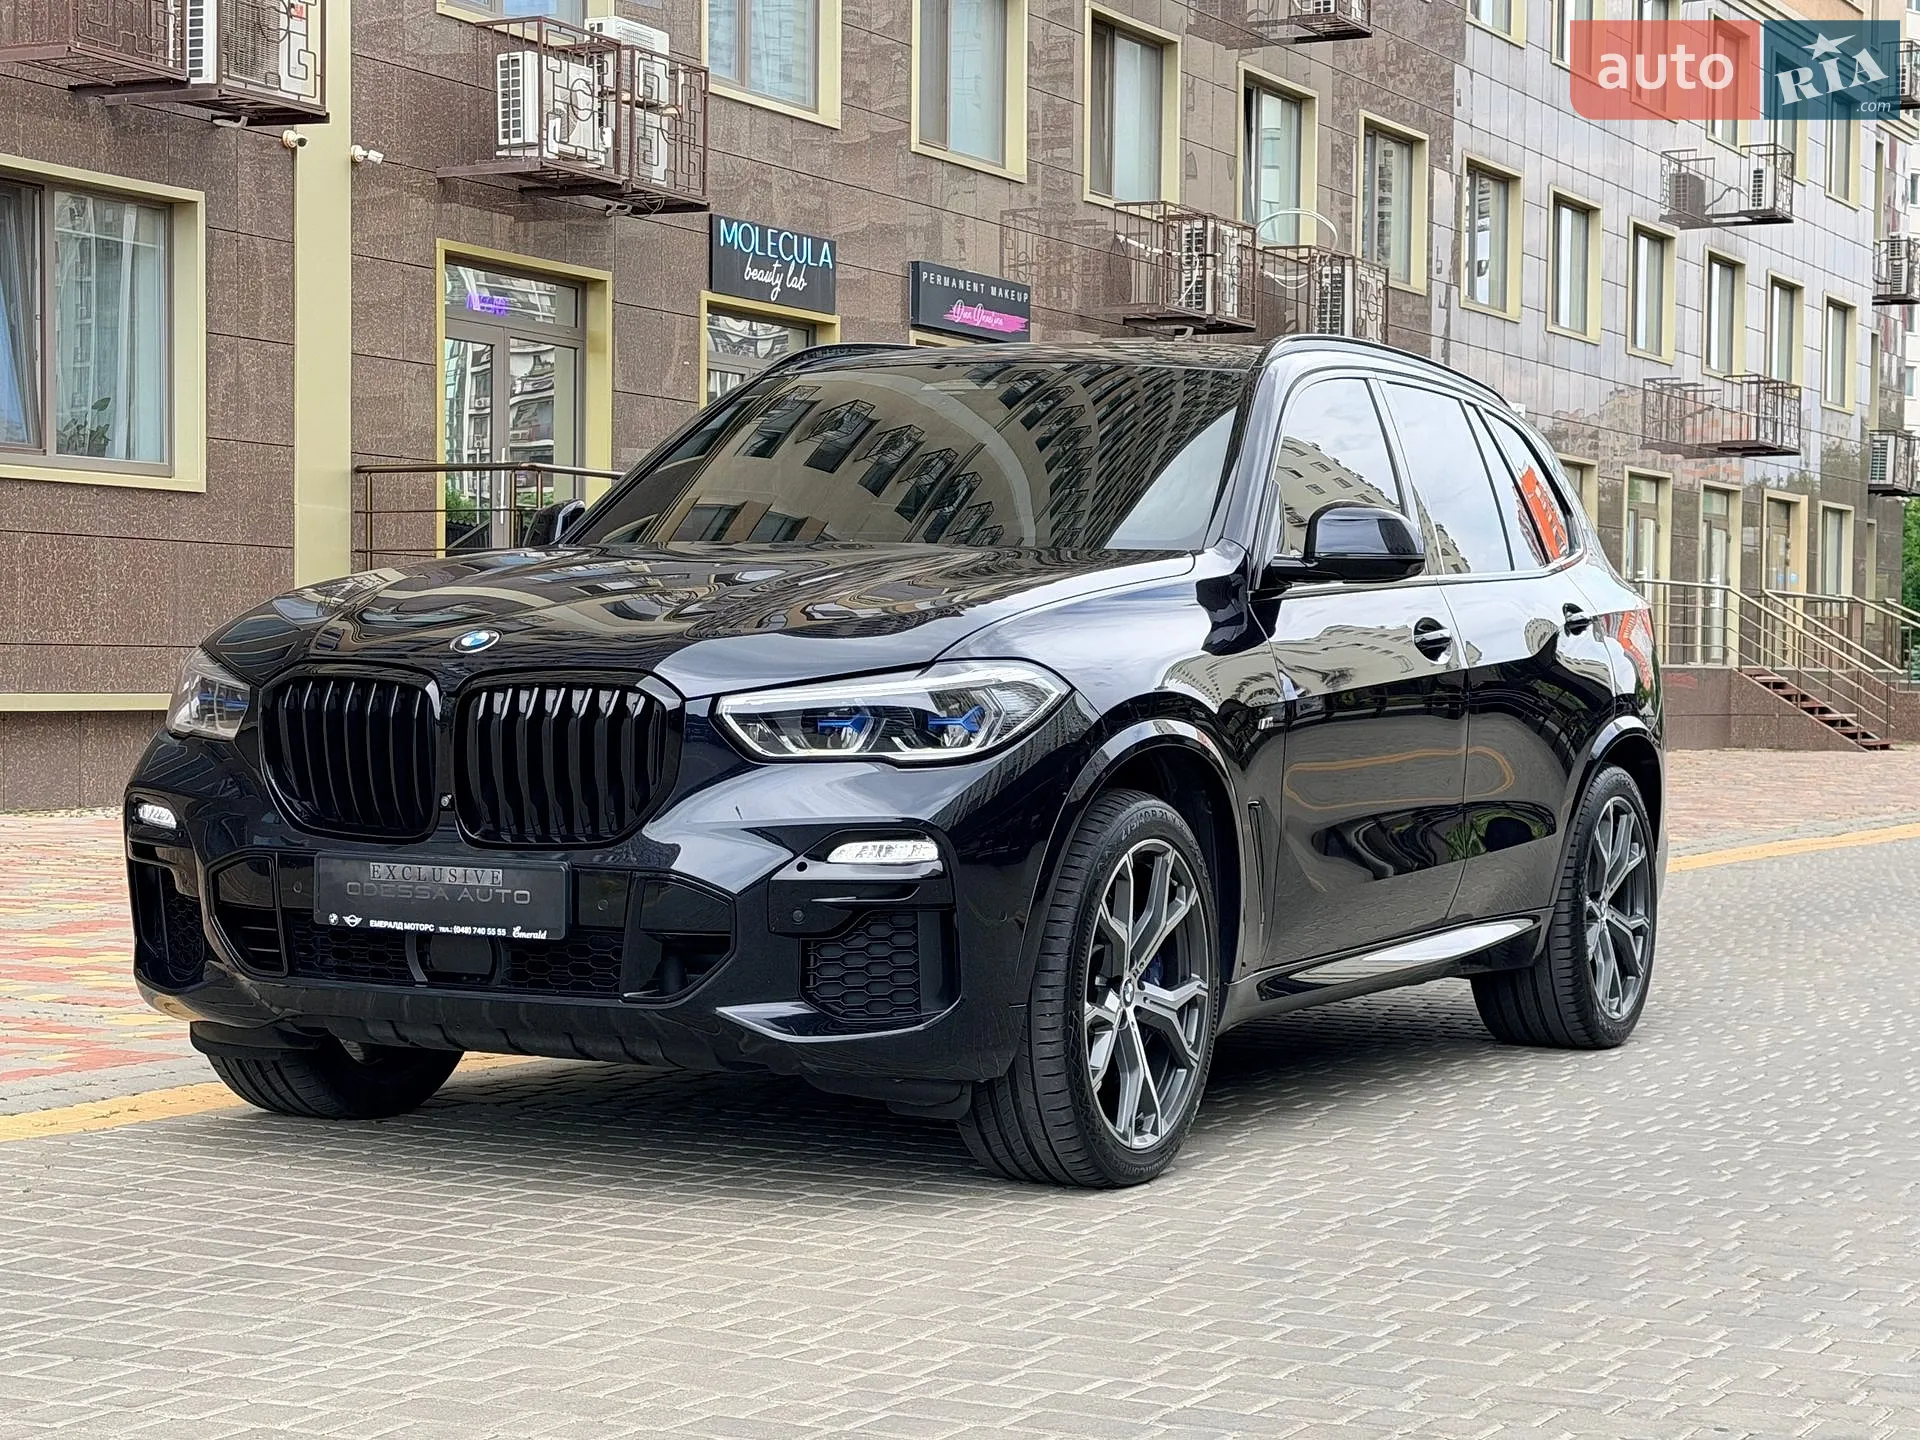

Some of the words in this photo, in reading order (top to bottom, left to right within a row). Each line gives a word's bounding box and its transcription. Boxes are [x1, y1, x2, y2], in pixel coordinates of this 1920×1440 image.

[720, 218, 833, 269] MOLECULA
[744, 252, 784, 302] beauty
[786, 260, 808, 291] lab
[922, 271, 985, 294] PERMANENT
[990, 286, 1029, 303] MAKEUP
[371, 864, 501, 886] EXCLUSIVE
[346, 882, 449, 900] ODESSA
[457, 887, 531, 904] AUTO
[369, 919, 403, 931] ЕМЕРАЛД
[404, 922, 435, 932] МОТОРС
[512, 926, 548, 940] Emerald
